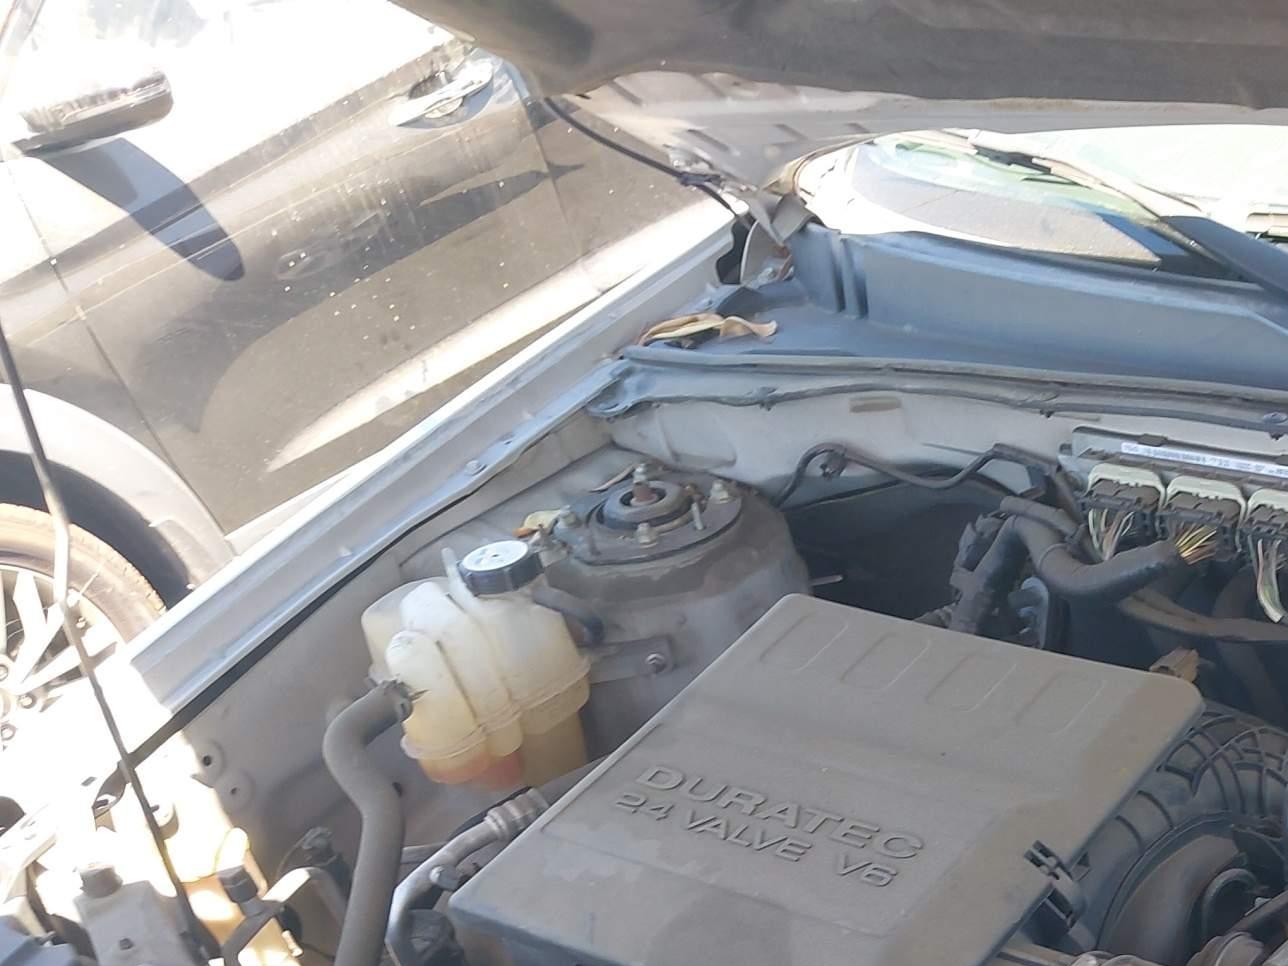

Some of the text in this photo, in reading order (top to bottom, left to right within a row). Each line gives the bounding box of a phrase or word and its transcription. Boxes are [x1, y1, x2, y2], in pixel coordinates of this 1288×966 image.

[615, 791, 899, 888] 24 VALVE V6
[635, 765, 924, 859] DURATEC
